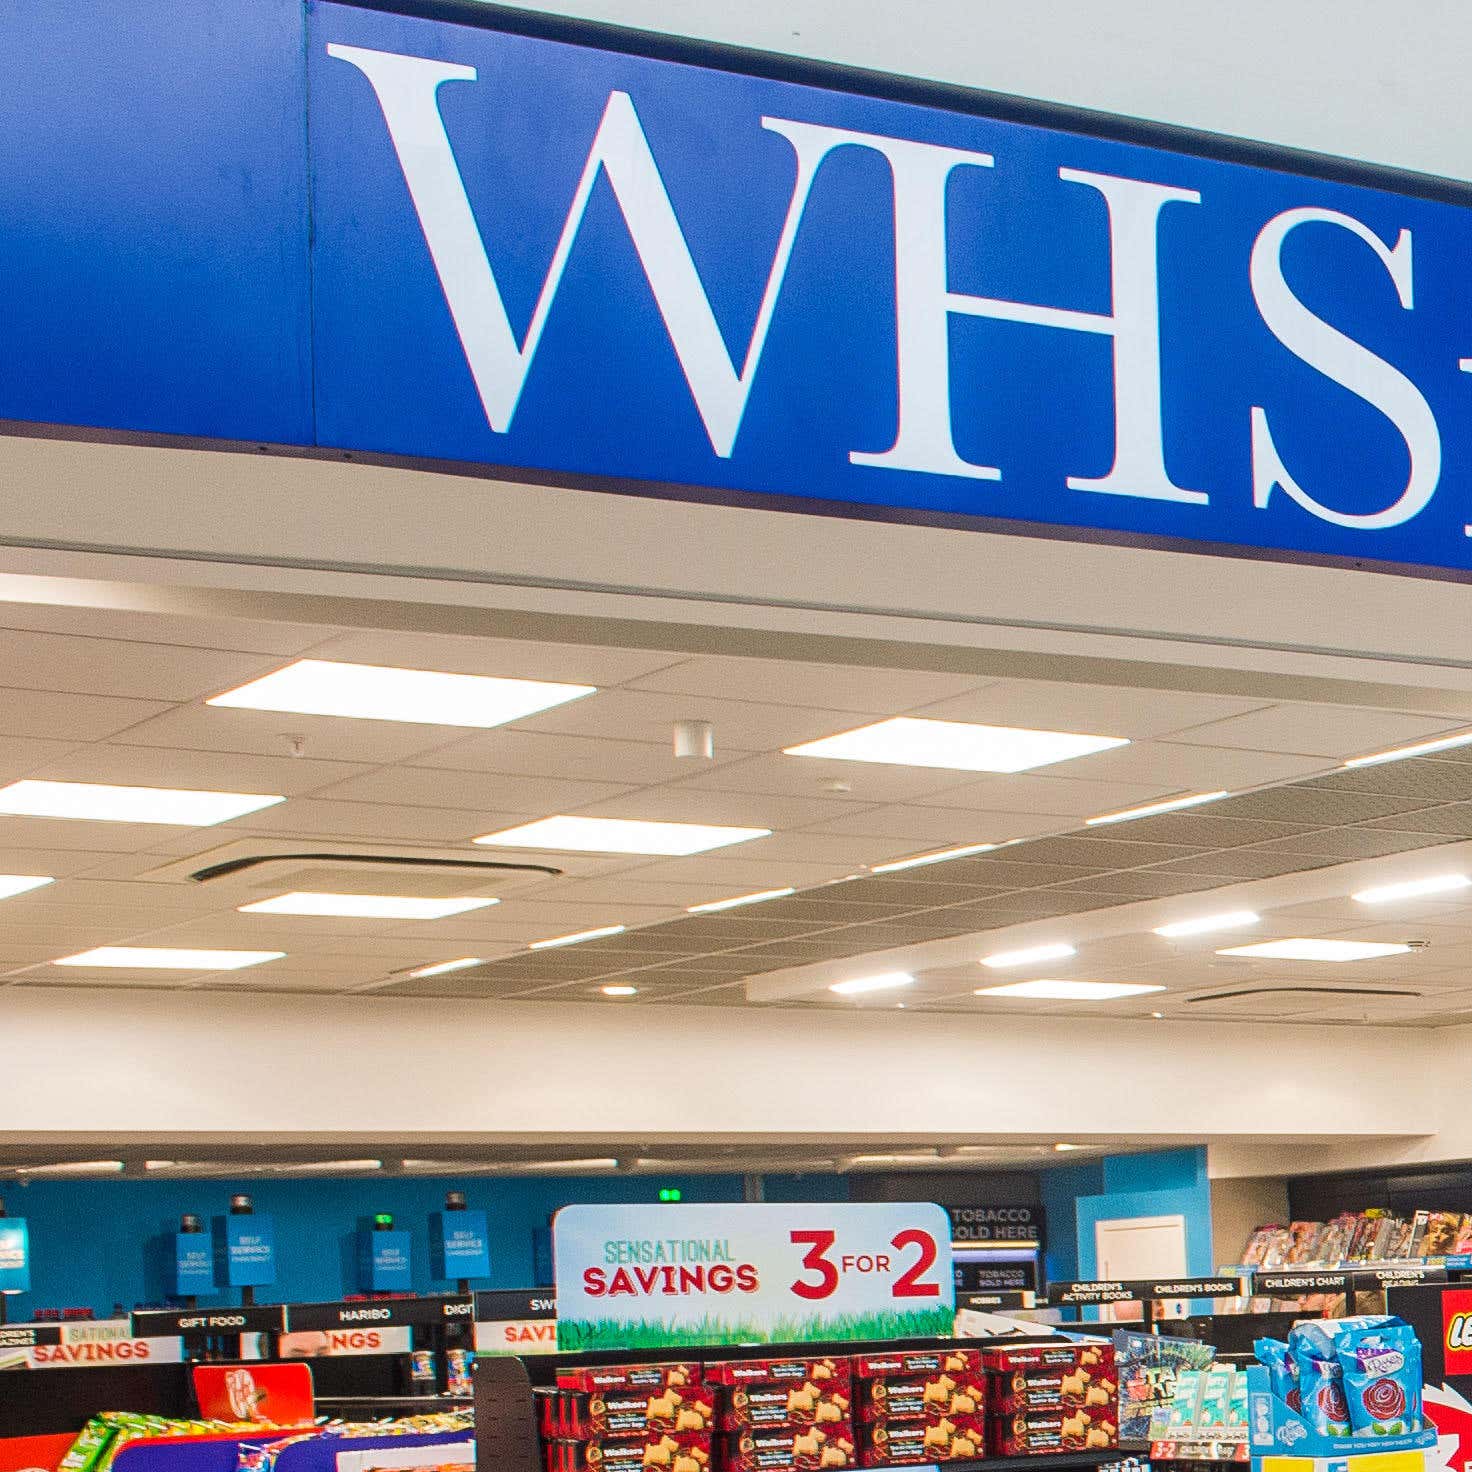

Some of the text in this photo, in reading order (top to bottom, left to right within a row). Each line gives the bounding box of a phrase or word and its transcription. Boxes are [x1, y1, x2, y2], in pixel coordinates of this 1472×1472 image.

[952, 1209, 1030, 1222] TOBACCO
[996, 1226, 1038, 1239] HERE
[605, 1240, 735, 1264] SENSATIONAL
[584, 1229, 940, 1300] SAVINGS 3 FOR 2
[1155, 1283, 1234, 1293] CHILDREN'S BOOKS
[1265, 1276, 1345, 1288] CHILDREN'S CHART
[1102, 1291, 1133, 1300] BOOKS
[339, 1309, 391, 1321] HARIBO
[178, 1316, 245, 1328] GIFT FOOD
[504, 1325, 557, 1342] SAVI
[33, 1341, 150, 1363] SAVINGS
[594, 1375, 626, 1384] Walkers
[1027, 1378, 1061, 1387] Walkers
[887, 1385, 924, 1394] Walkers
